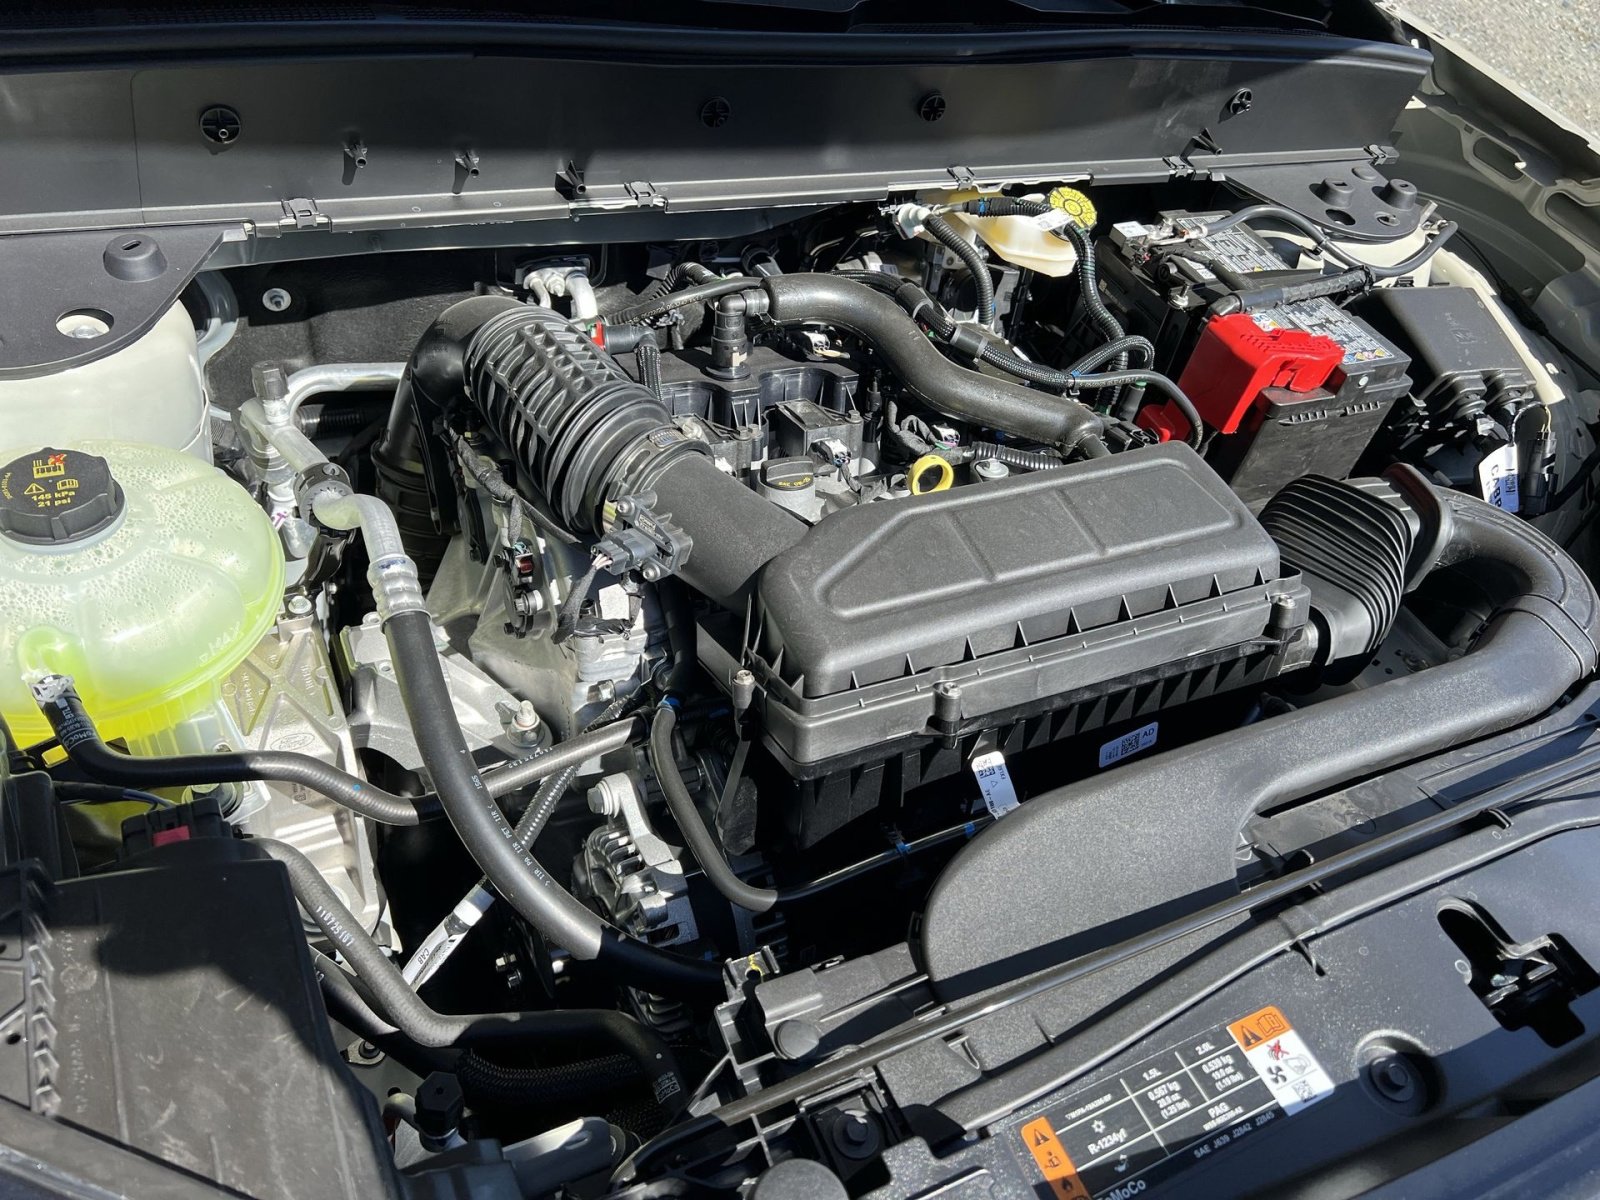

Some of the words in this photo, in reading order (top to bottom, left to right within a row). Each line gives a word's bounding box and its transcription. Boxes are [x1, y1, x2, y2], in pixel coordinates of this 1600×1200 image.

[31, 492, 52, 501] 145
[54, 490, 76, 498] kPa
[37, 500, 51, 508] 21
[54, 497, 72, 507] psi
[1141, 727, 1155, 738] AD
[417, 947, 430, 965] CAB
[1195, 1041, 1215, 1055] 2.0L
[1220, 1054, 1235, 1066] kg
[1142, 1067, 1162, 1081] 1.5L
[1166, 1080, 1181, 1092] kg
[1207, 1101, 1230, 1119] PAG
[1087, 1127, 1128, 1155] R-1234yf
[1193, 1144, 1211, 1159] SAE
[1099, 1177, 1147, 1200] MoCo
